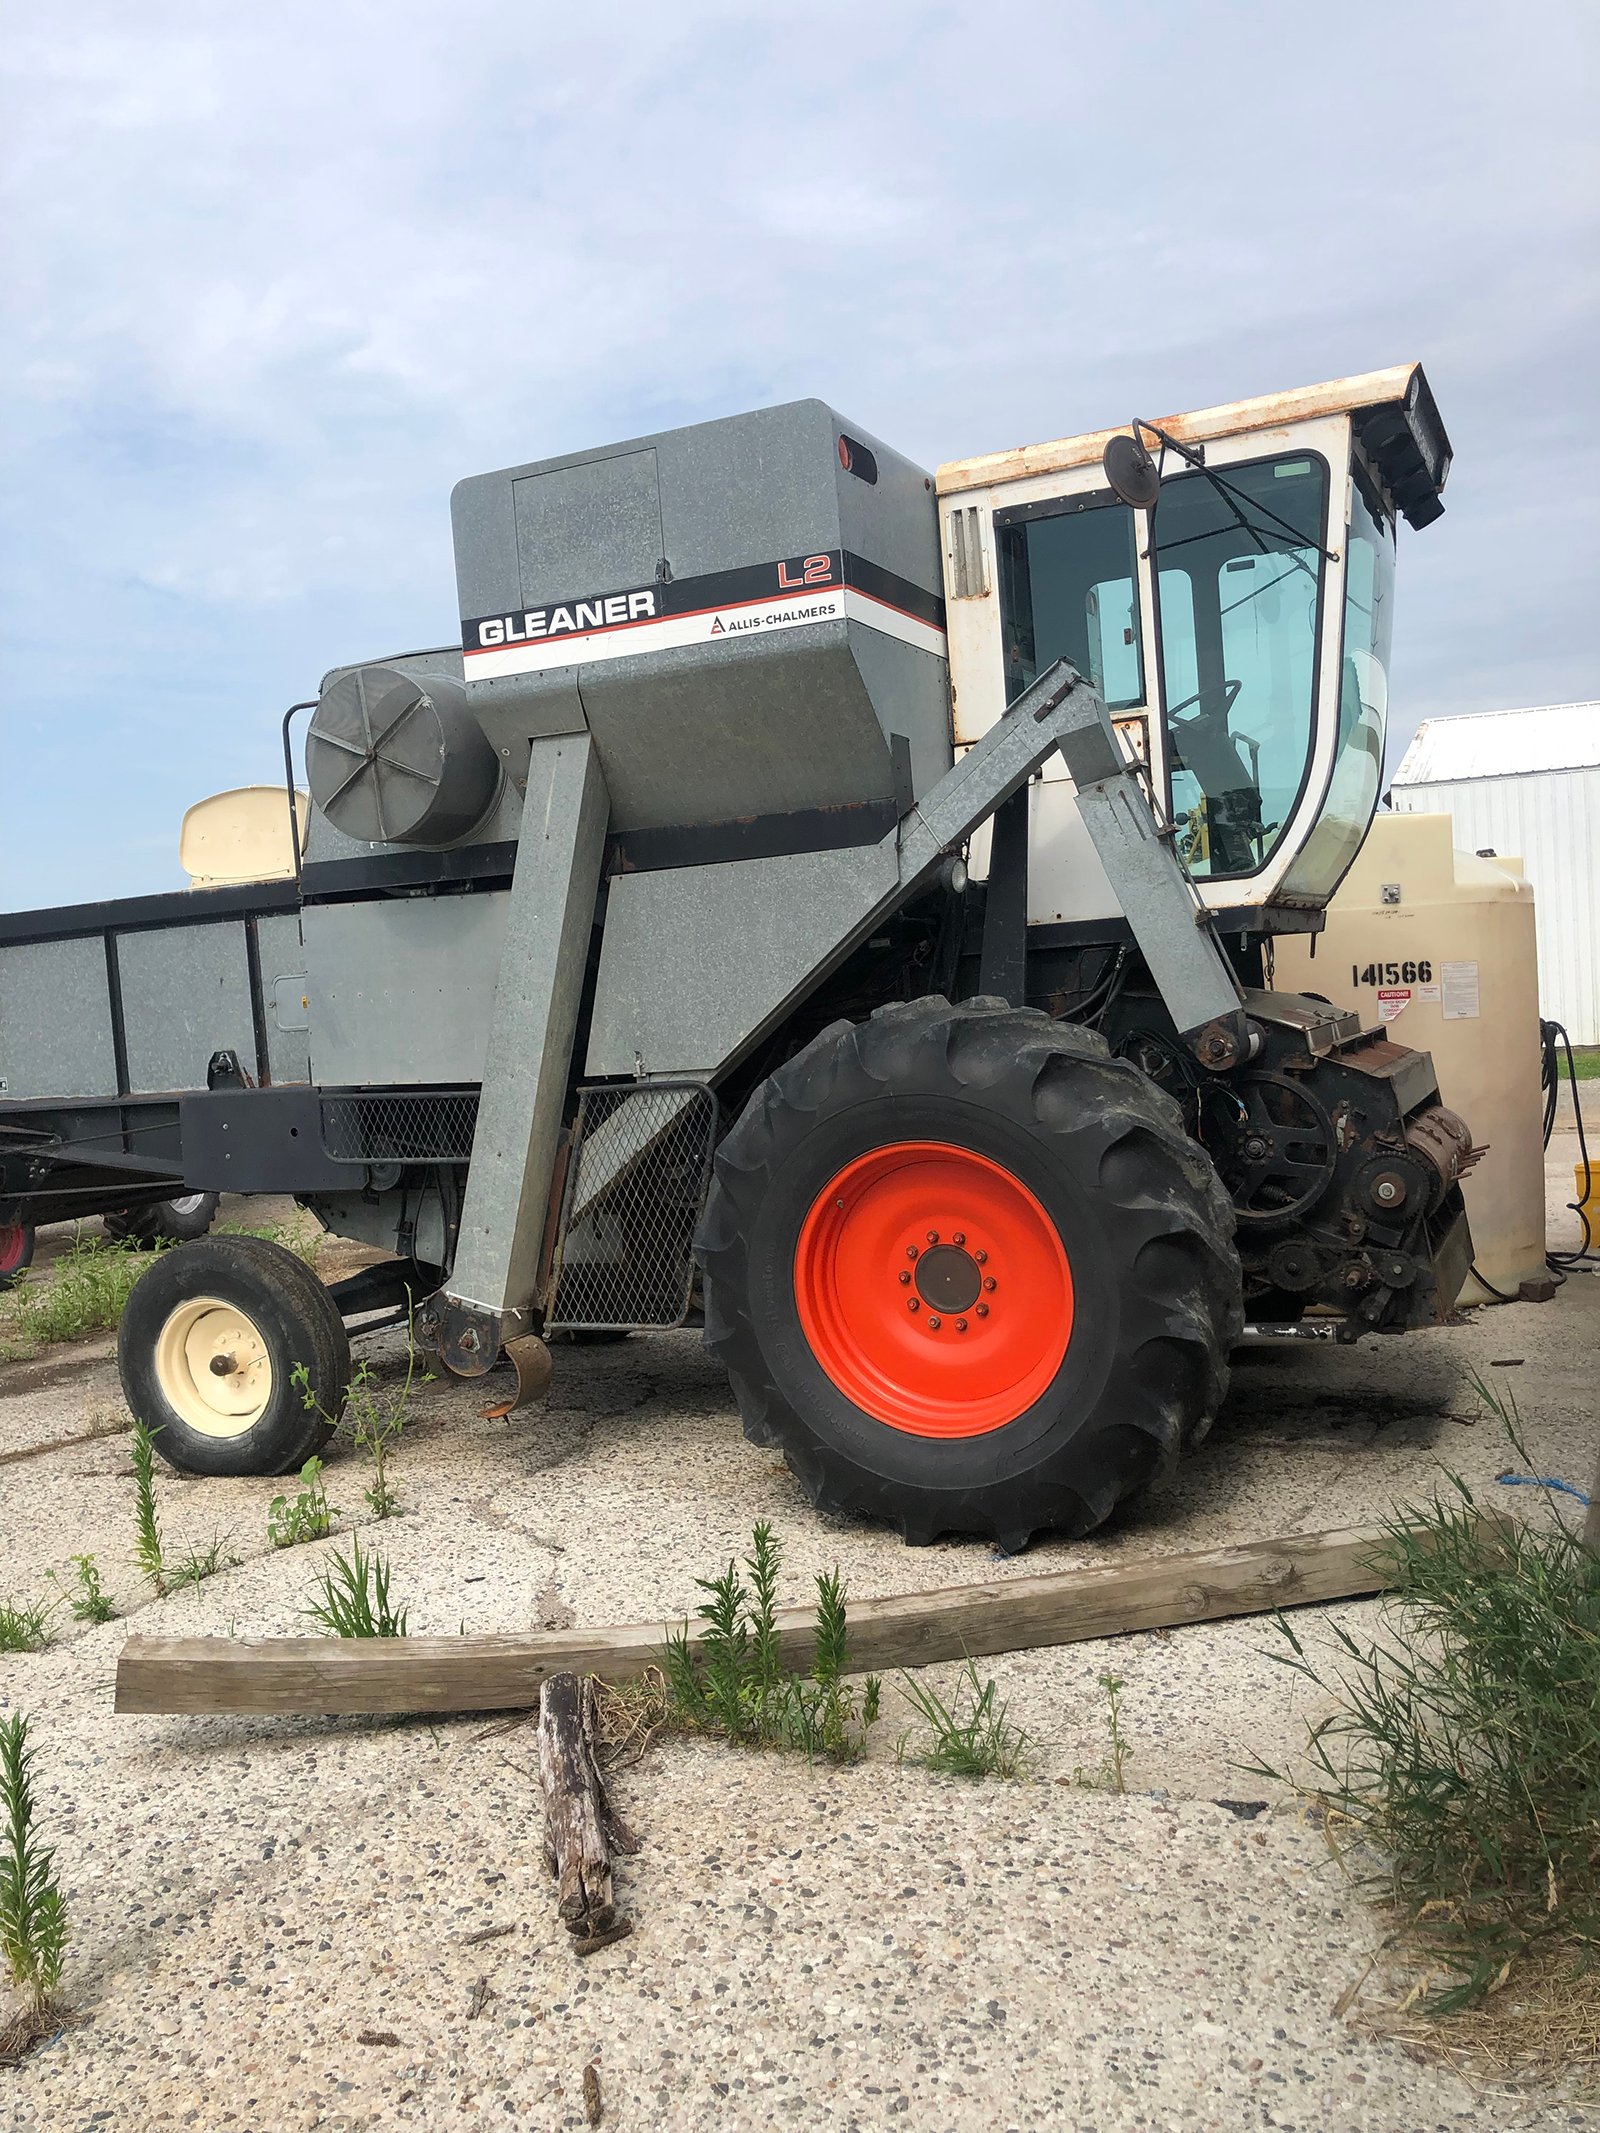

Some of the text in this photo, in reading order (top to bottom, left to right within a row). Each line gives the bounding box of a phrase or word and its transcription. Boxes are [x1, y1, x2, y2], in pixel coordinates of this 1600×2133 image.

[777, 554, 832, 589] L2
[478, 590, 656, 646] GLEANER
[728, 604, 836, 632] ALLIS-CHALMERS
[1352, 960, 1432, 988] 141566
